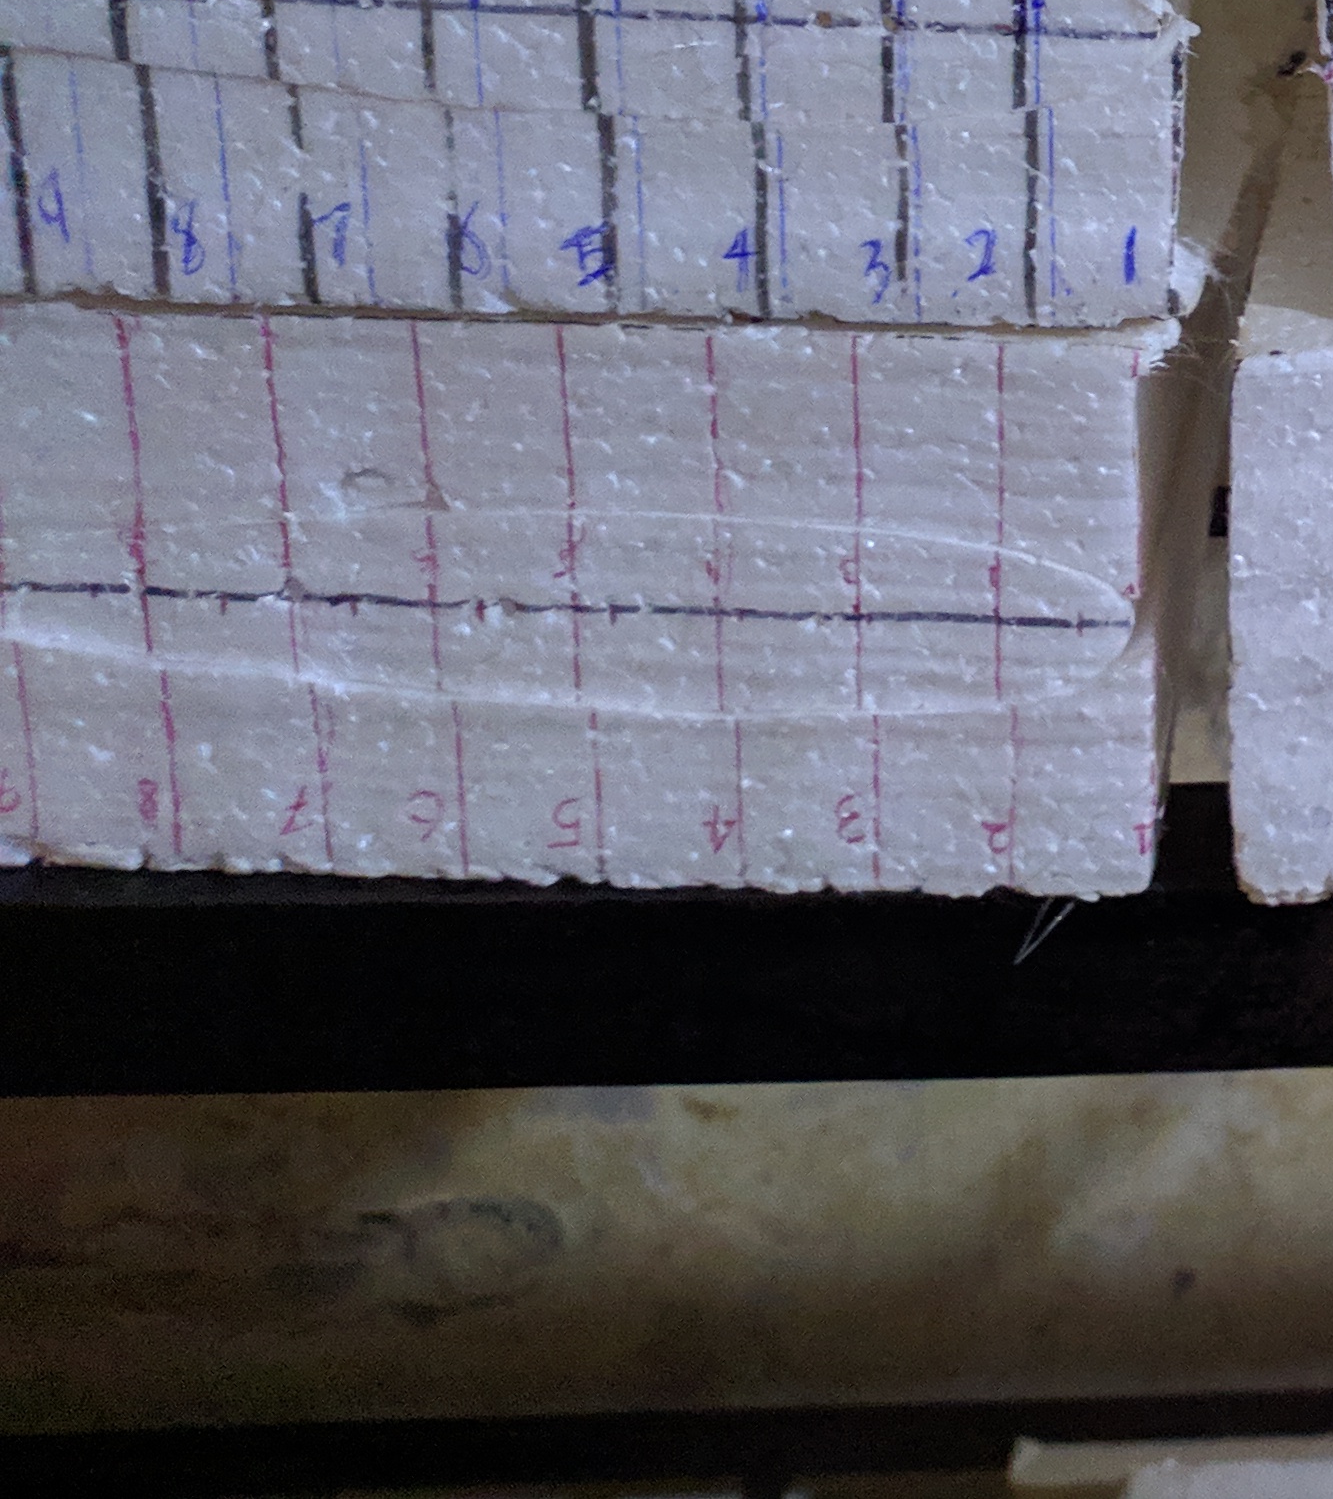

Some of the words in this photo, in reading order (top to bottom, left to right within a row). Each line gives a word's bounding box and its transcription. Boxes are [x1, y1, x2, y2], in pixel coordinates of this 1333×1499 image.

[723, 226, 758, 293] 4
[860, 237, 892, 305] 3
[964, 228, 998, 283] 2
[1123, 225, 1138, 285] 1
